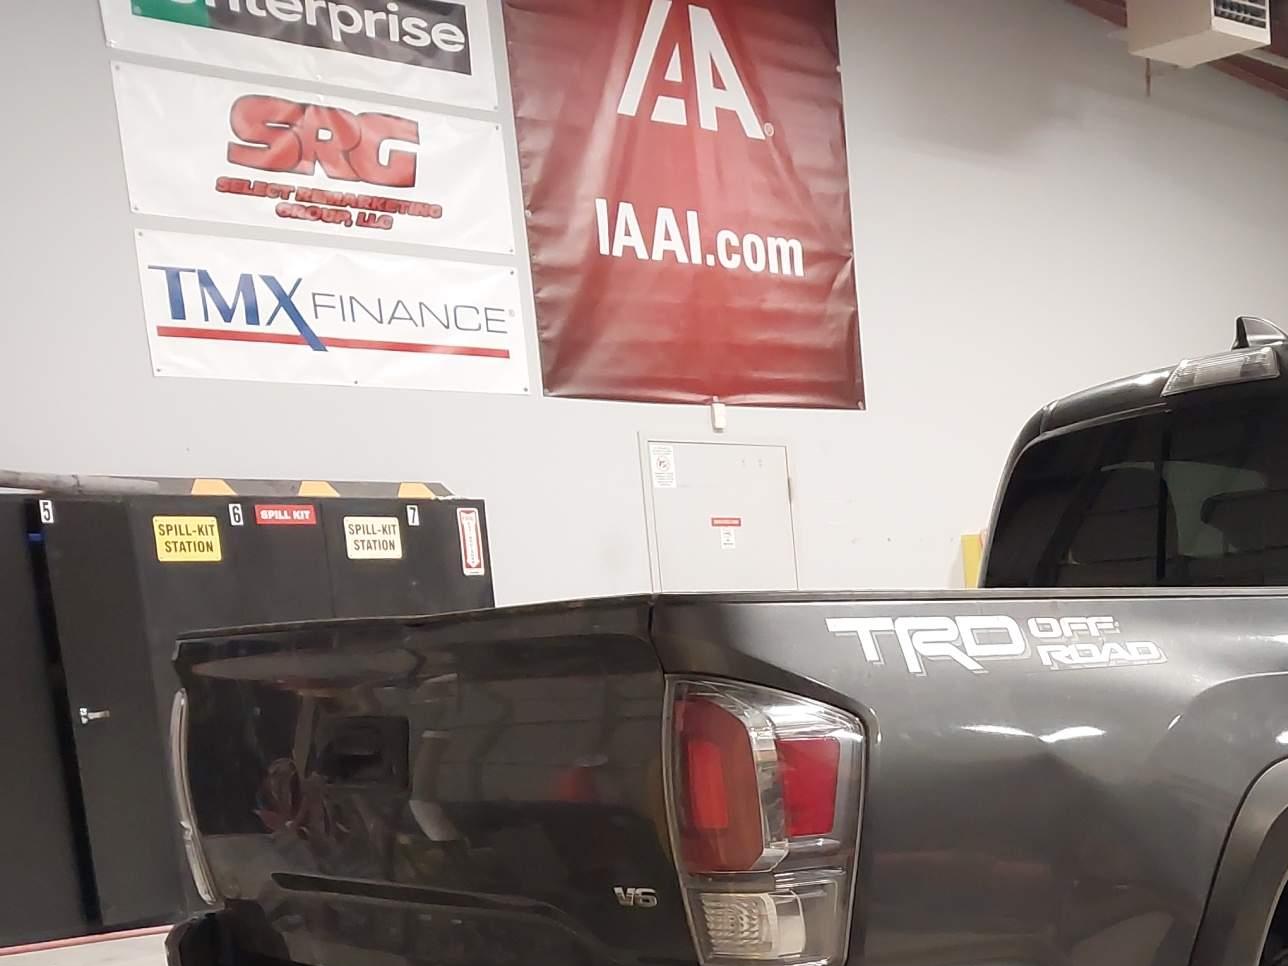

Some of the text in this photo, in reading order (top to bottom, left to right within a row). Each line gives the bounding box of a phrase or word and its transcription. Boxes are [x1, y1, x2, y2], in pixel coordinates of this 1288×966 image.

[170, 0, 466, 52] erprise
[227, 94, 420, 188] SRG
[216, 176, 295, 200] SELECT
[275, 202, 353, 227] GROUP,
[595, 198, 805, 277] IAAI.com
[148, 265, 508, 352] TMX FINANCE
[43, 501, 51, 521] 5
[231, 505, 241, 524] 6
[261, 509, 311, 520] SPILL KIT
[410, 506, 417, 524] 7
[158, 523, 215, 536] SPILL-KIT
[348, 523, 397, 535] SPILL-KIT
[165, 541, 214, 553] STATION
[353, 539, 396, 551] STATION
[825, 615, 1120, 676] TRD OFF
[1036, 640, 1168, 671] ROAD
[613, 887, 658, 908] V6
